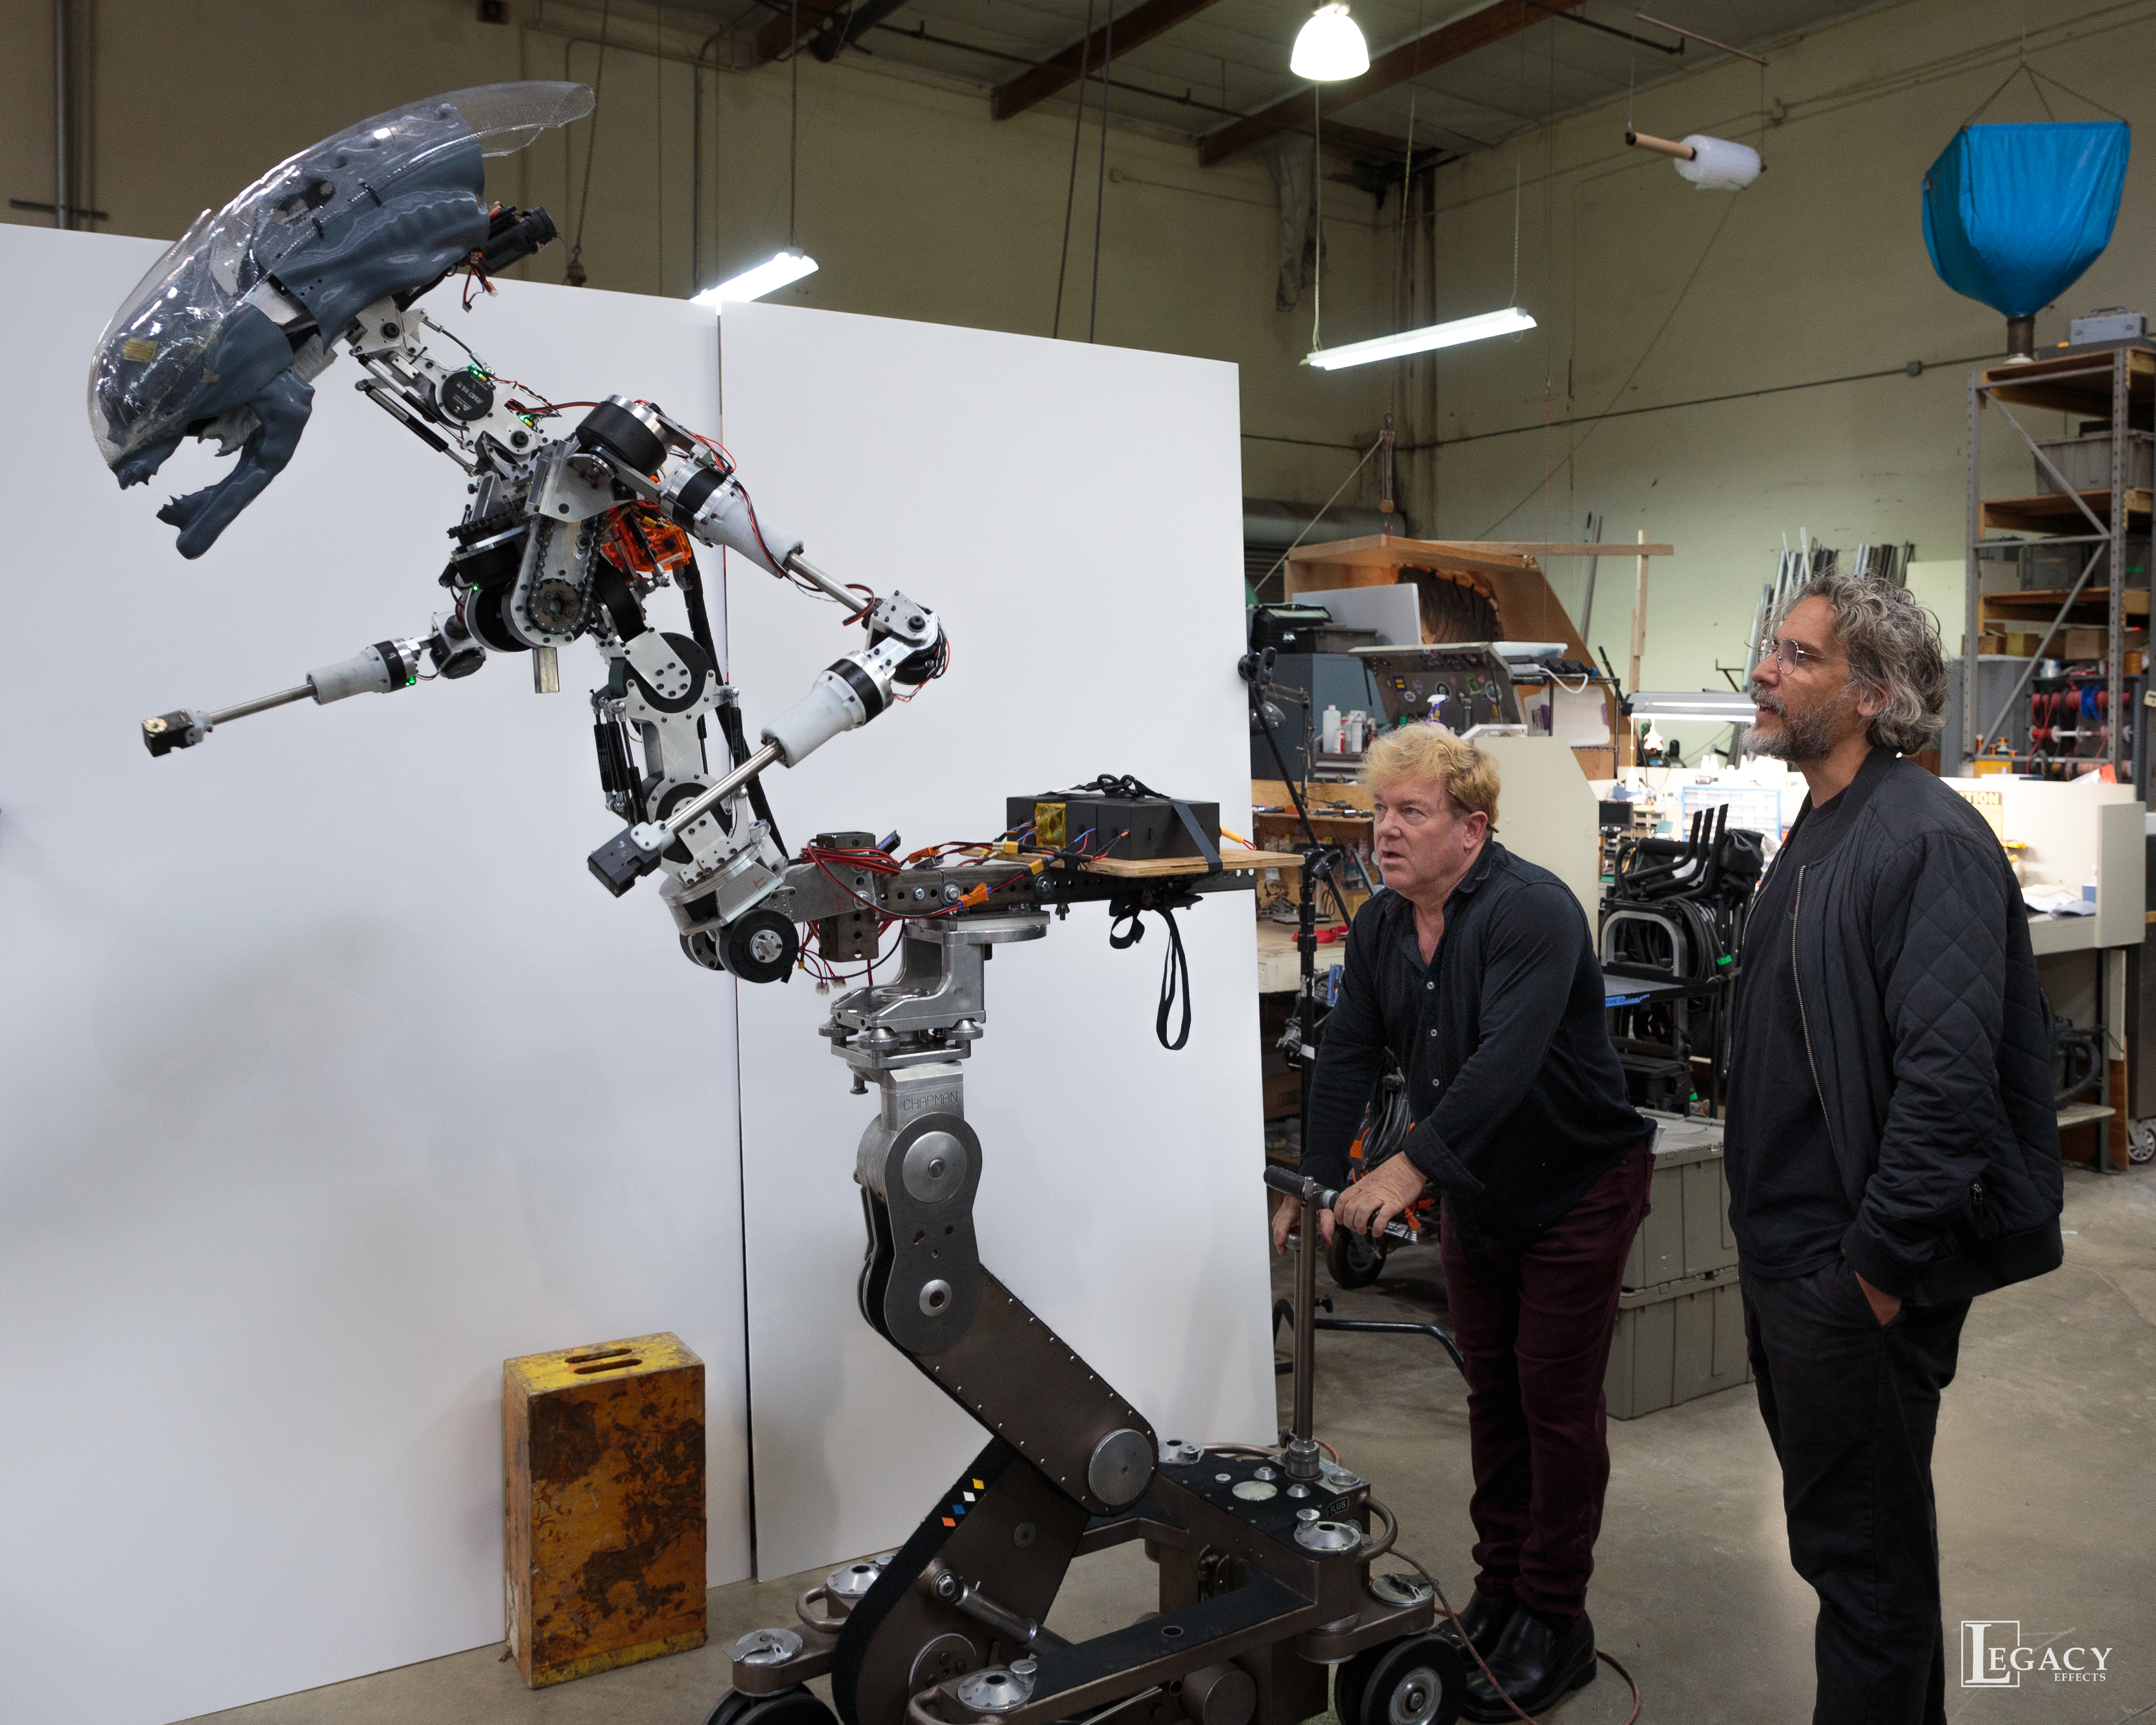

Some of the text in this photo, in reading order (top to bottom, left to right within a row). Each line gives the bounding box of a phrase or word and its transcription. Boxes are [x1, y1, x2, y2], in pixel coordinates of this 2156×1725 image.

[1959, 791, 1999, 805] TION
[903, 1091, 958, 1111] CHAPMAN
[1330, 1500, 1346, 1514] PLUS
